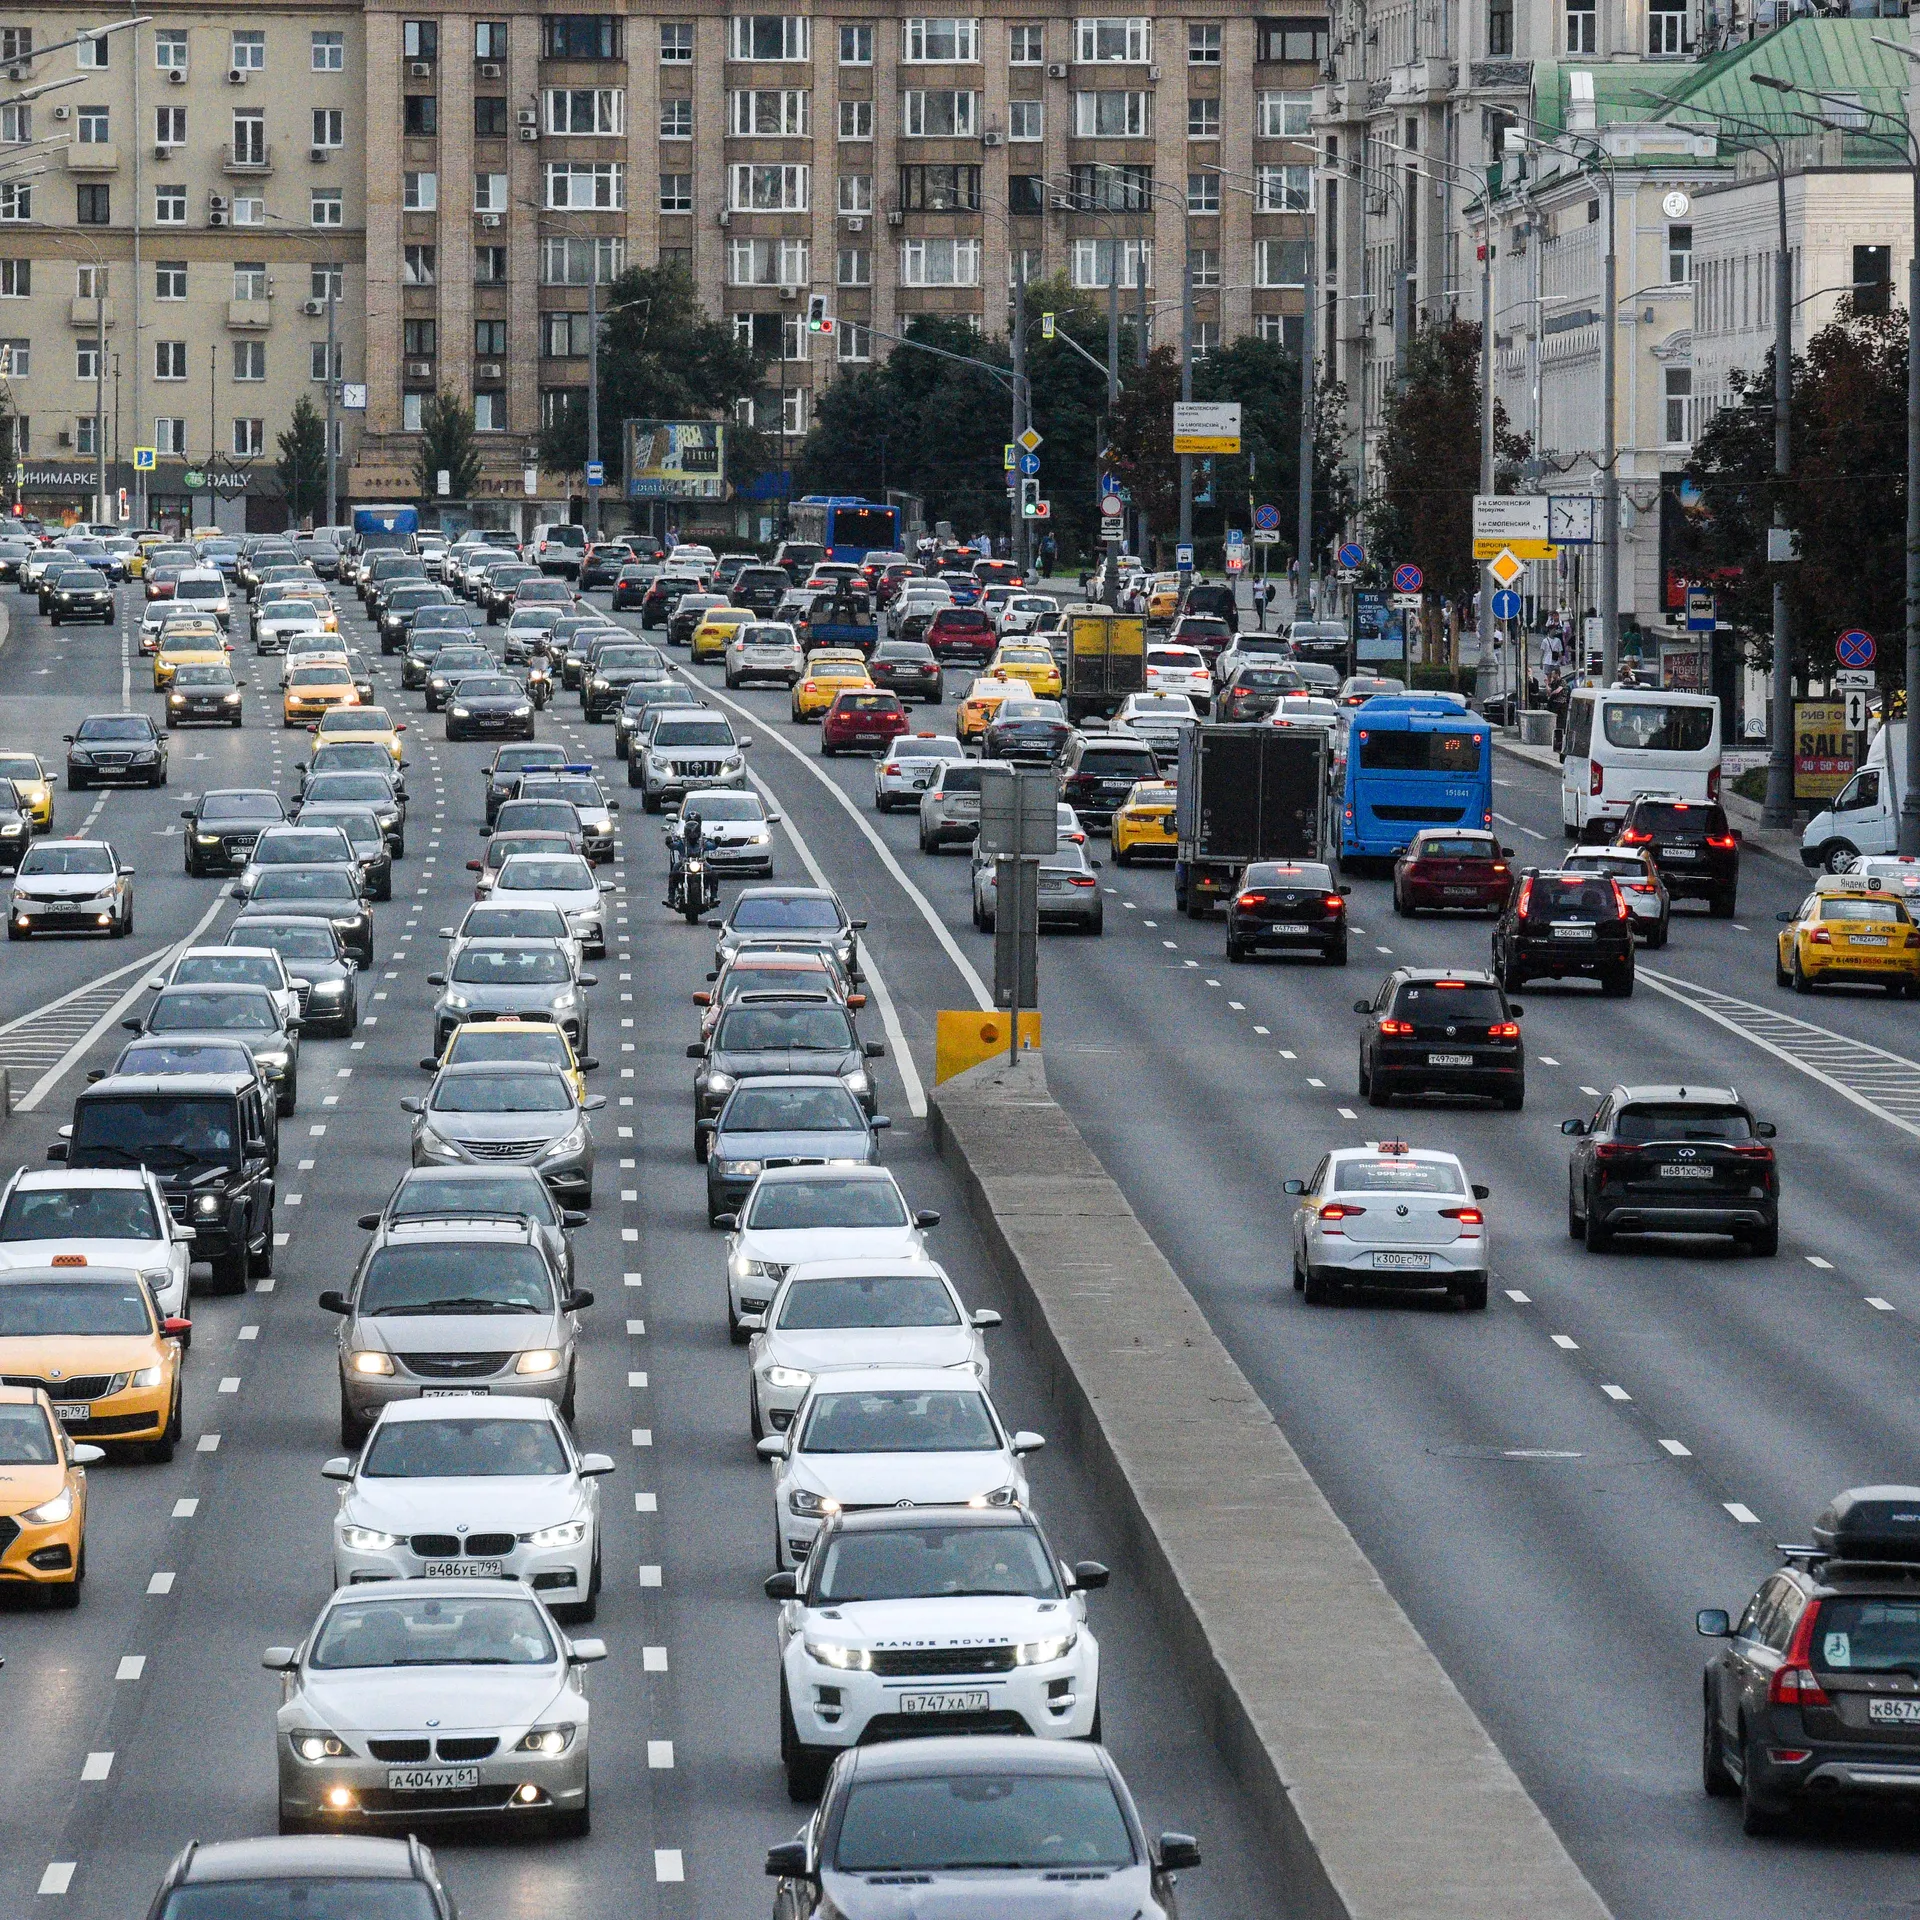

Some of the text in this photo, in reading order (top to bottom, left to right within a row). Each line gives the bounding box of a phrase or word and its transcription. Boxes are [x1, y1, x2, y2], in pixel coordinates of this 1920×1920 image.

[7, 473, 107, 486] МИНИМАРКЕ
[208, 474, 252, 487] DAILY
[1488, 499, 1531, 507] СМОЛЕНСКИЙ
[1800, 710, 1847, 721] РИВ ГО
[1799, 733, 1854, 758] SALE
[1840, 878, 1867, 889] Яндекс
[1662, 1166, 1712, 1176] Н681ХС 799
[1376, 1254, 1428, 1264] К300ЕС 797
[430, 1562, 498, 1577] В486УЕ 799
[876, 1637, 1009, 1648] RANGE ROVER
[907, 1693, 983, 1711] В747ХА 77
[394, 1769, 474, 1788] А404УХ 61
